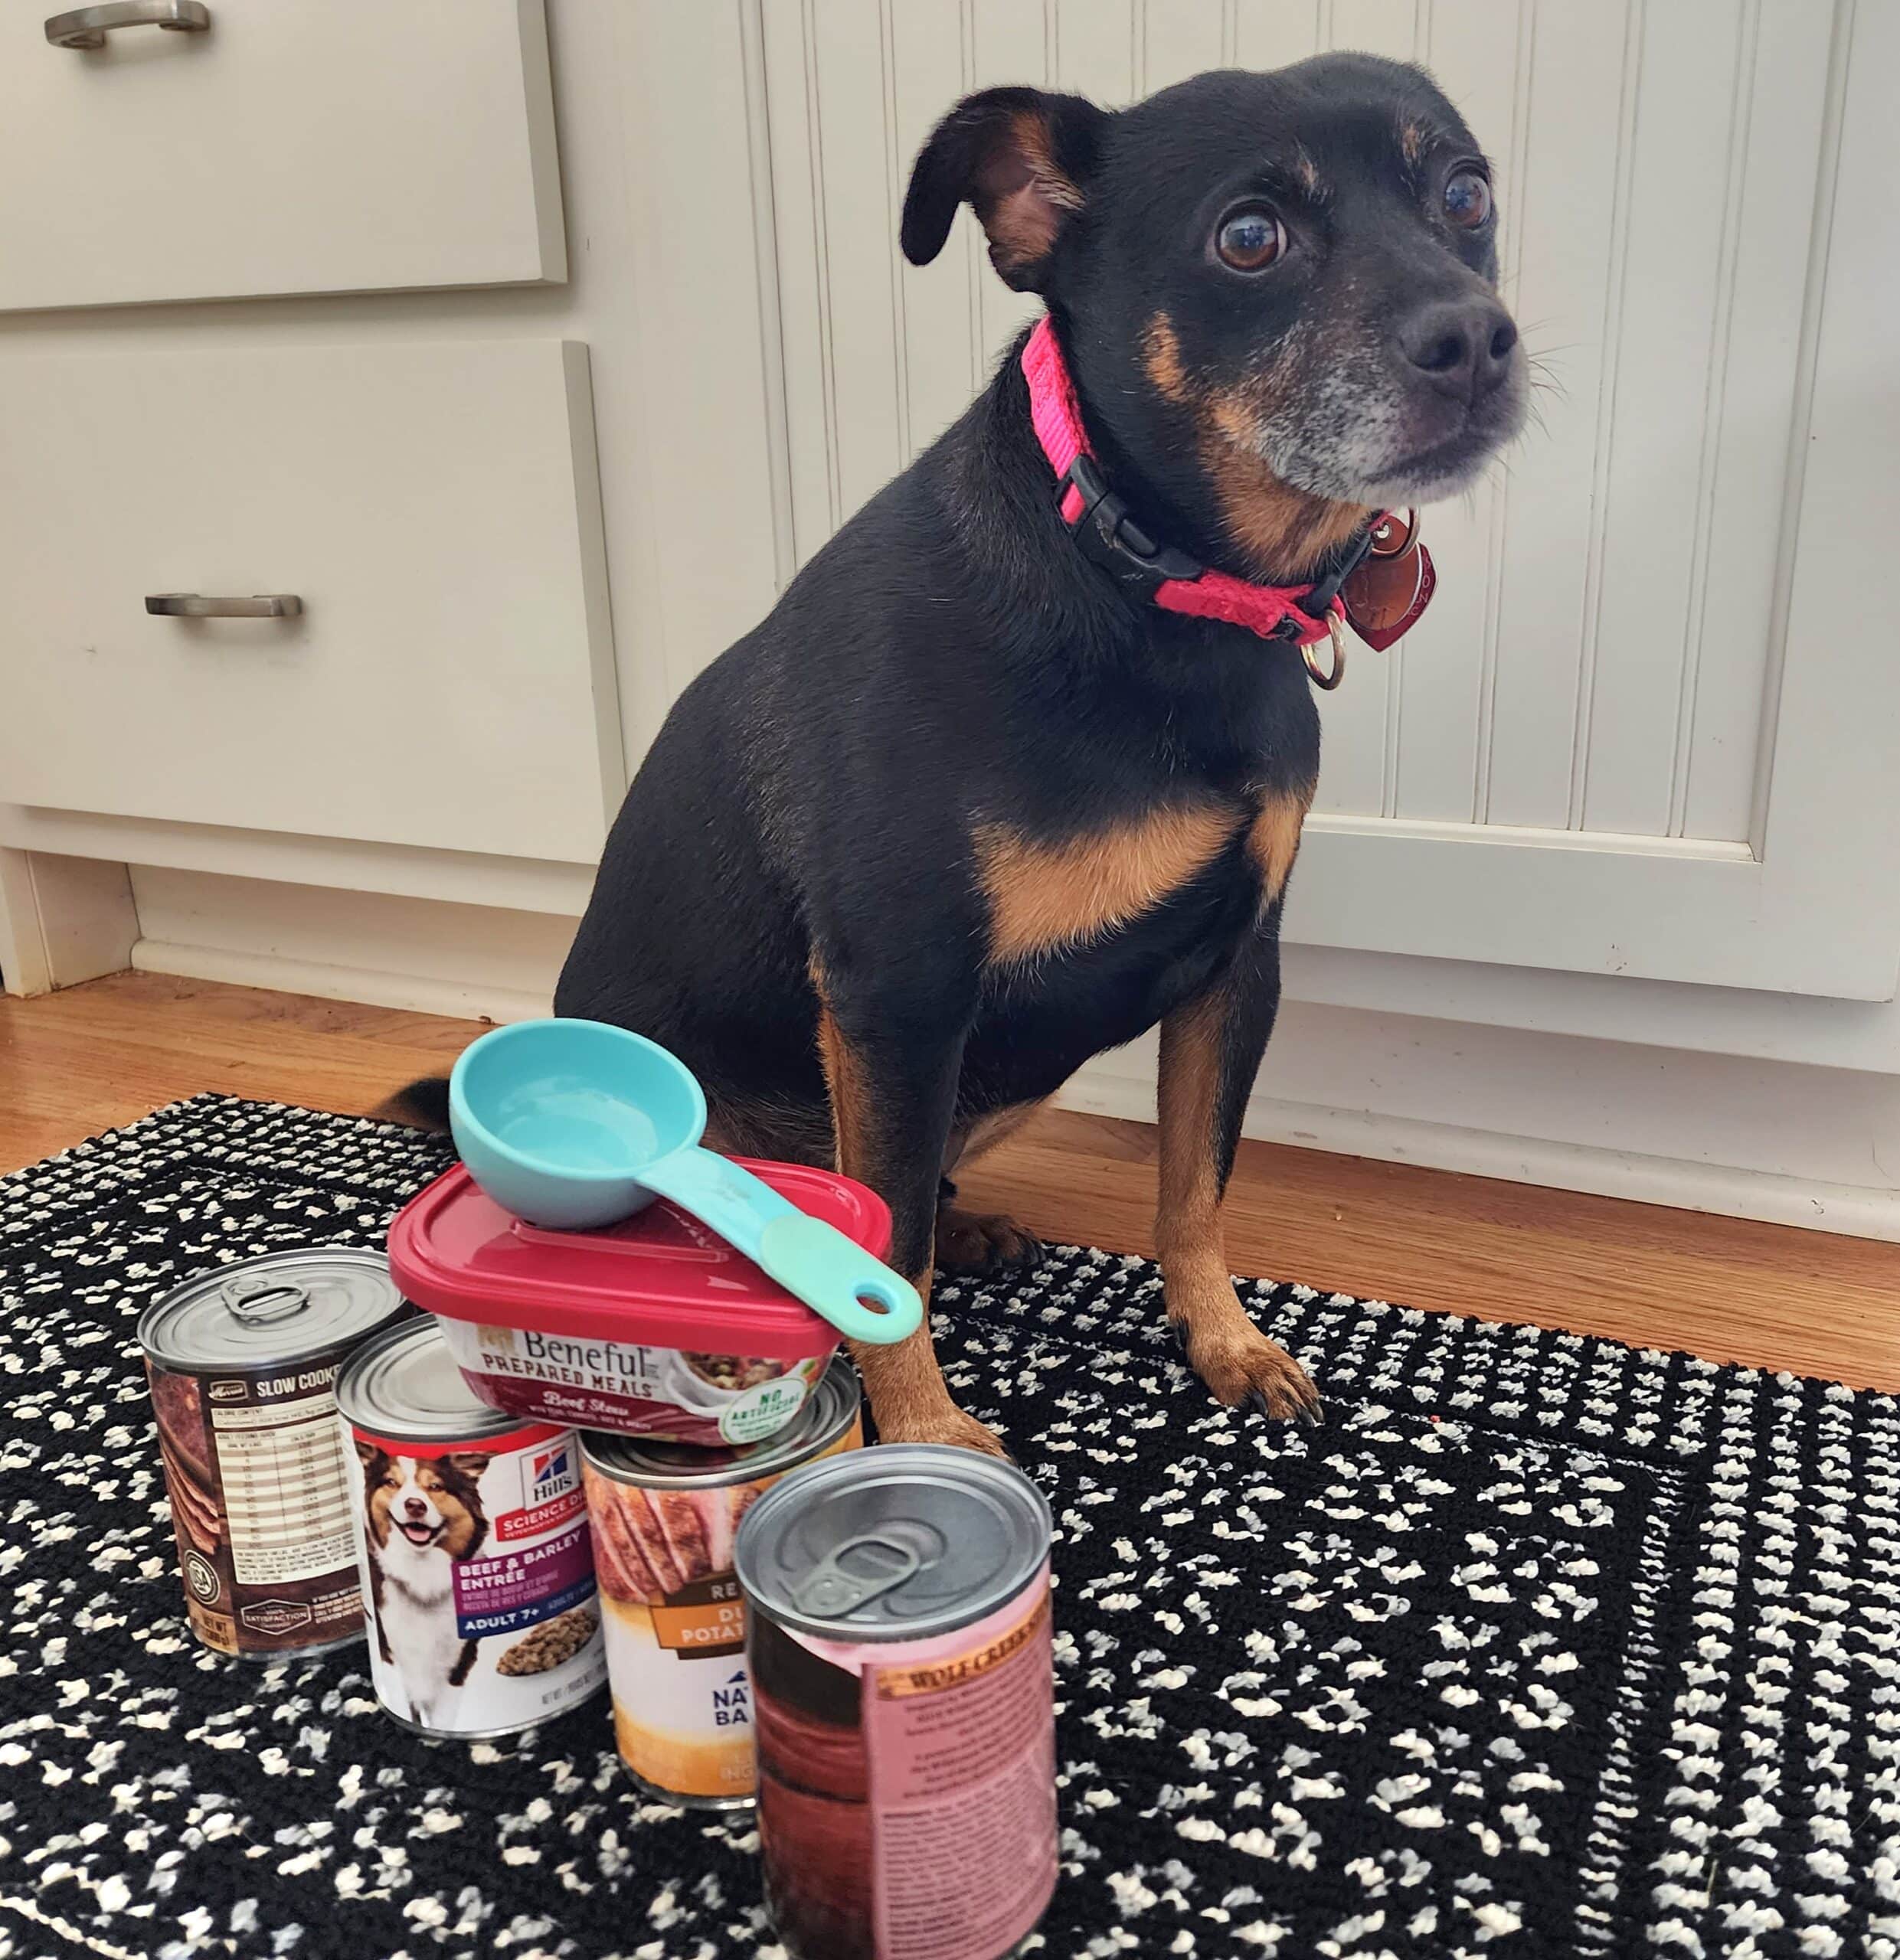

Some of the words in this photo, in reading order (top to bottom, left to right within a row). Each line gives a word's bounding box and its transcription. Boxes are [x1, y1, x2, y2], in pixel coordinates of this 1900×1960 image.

[525, 1330, 646, 1377] Beneful
[482, 1354, 584, 1385] PREPARED
[591, 1374, 652, 1397] MEALS
[257, 1377, 296, 1397] SLOW
[760, 1390, 782, 1405] NO
[543, 1390, 586, 1411] Beef
[589, 1399, 629, 1416] Stew
[534, 1476, 573, 1501] Hill's
[503, 1500, 566, 1531] SCIENCE
[570, 1491, 583, 1506] DI
[459, 1560, 502, 1577] BEEF
[506, 1557, 518, 1570] &
[523, 1531, 581, 1565] BARLEY
[711, 1583, 737, 1599] RE
[465, 1612, 517, 1630] ADULT
[520, 1609, 539, 1620] 7+
[718, 1607, 744, 1622] DI
[682, 1623, 744, 1642] POTAT
[910, 1660, 970, 1687] WOLF
[713, 1687, 748, 1709] NA
[715, 1709, 748, 1726] BA
